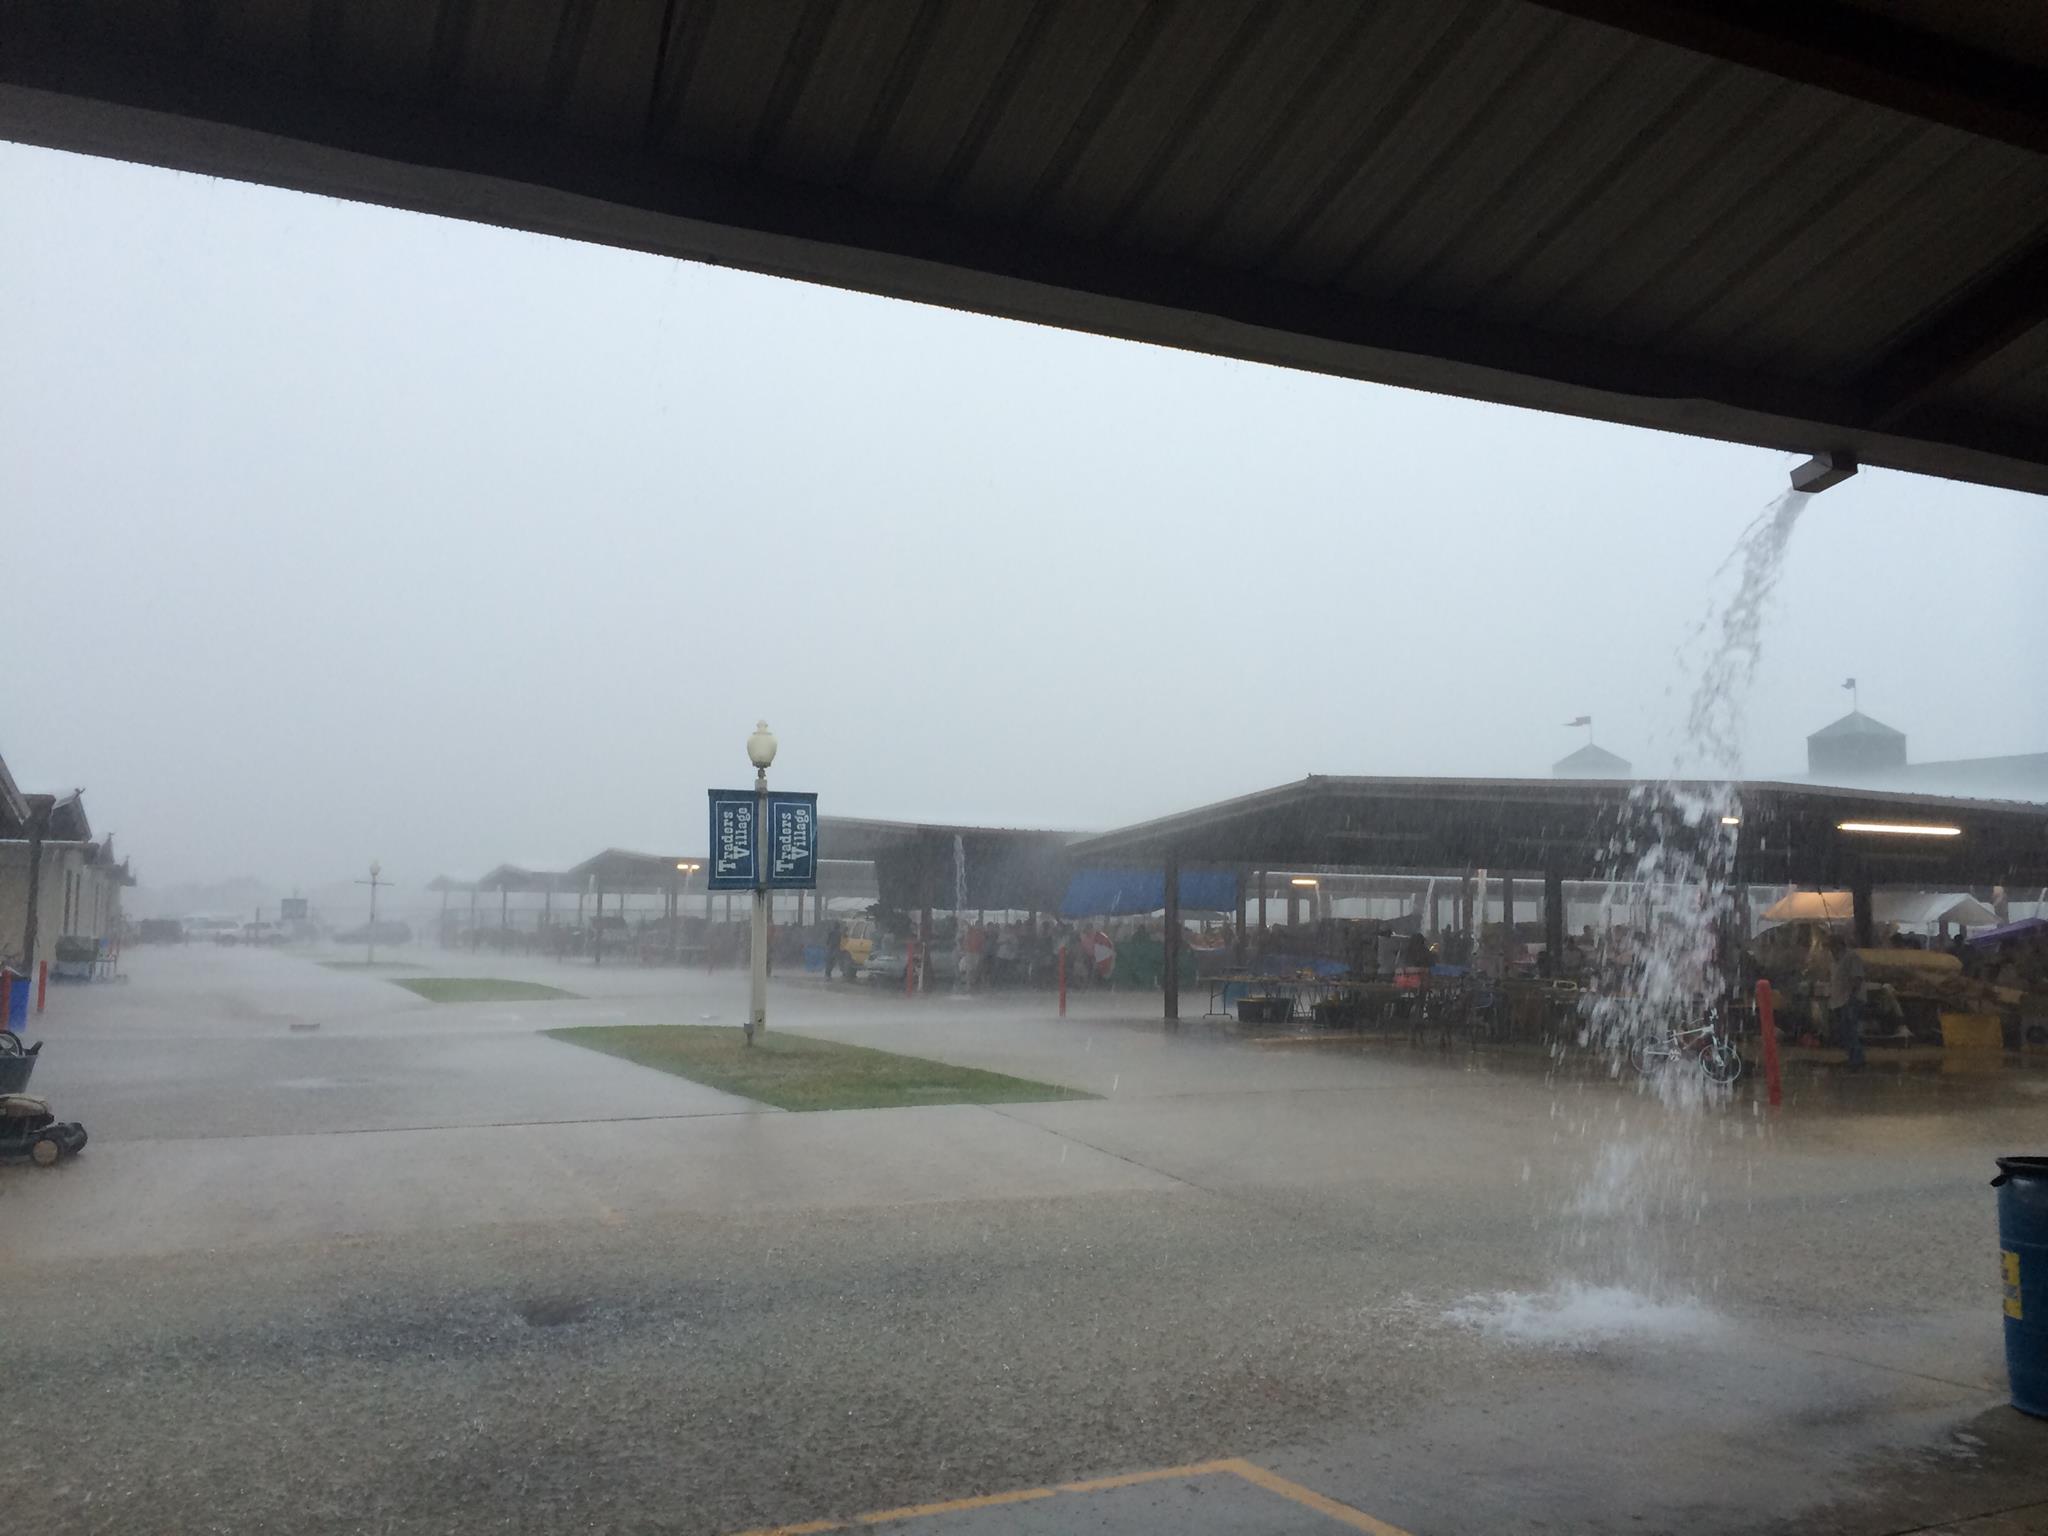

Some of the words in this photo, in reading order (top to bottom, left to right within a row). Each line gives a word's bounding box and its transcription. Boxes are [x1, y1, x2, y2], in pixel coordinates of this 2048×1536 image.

[718, 811, 736, 872] Traders
[733, 807, 751, 859] Village
[776, 812, 794, 872] Traders
[791, 809, 809, 860] Village
